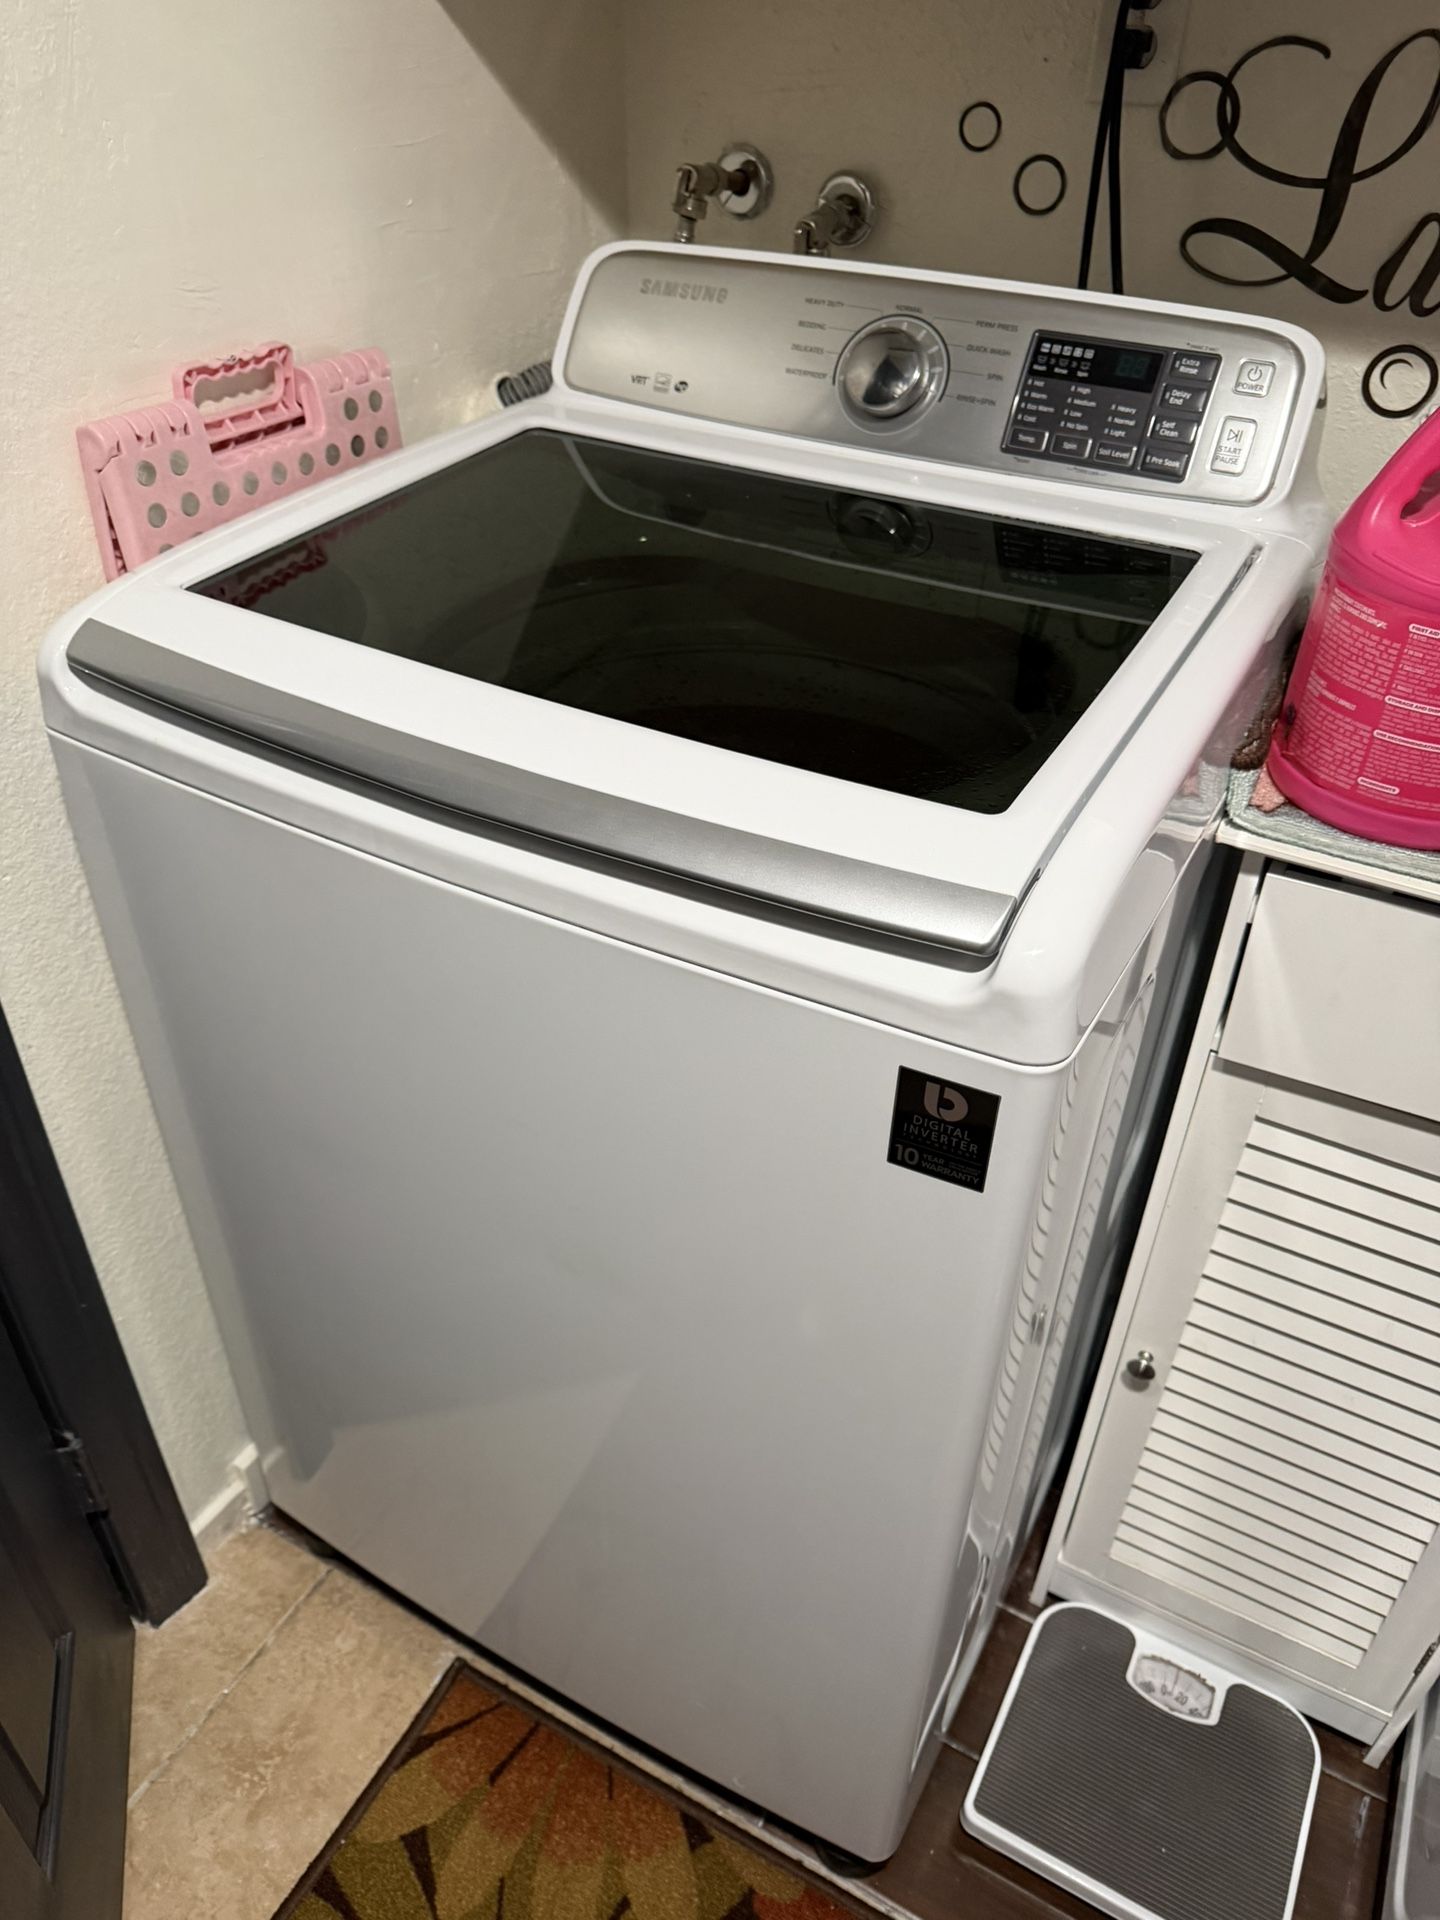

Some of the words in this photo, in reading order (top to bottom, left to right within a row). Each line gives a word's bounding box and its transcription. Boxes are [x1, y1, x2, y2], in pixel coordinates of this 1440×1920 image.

[640, 278, 729, 304] SAMSUNG
[805, 297, 826, 305] HEAVY
[975, 320, 996, 329] PERM
[997, 323, 1018, 332] PRESS
[966, 344, 988, 354] QUICK
[989, 347, 1011, 356] WASH
[1181, 358, 1200, 367] Extra
[1179, 366, 1198, 375] Rinse
[987, 373, 1003, 381] SPIN
[1033, 380, 1045, 388] Hot
[1238, 382, 1264, 393] POWER
[1076, 386, 1091, 395] High
[1171, 389, 1192, 400] Delay
[1073, 398, 1097, 407] Medium
[1168, 397, 1184, 406] End
[1069, 410, 1082, 418] Low
[1117, 405, 1137, 415] Heavy
[1113, 417, 1136, 427] Normal
[1162, 420, 1176, 430] Self
[1109, 428, 1126, 438] Light
[1159, 428, 1179, 438] Clean
[1063, 441, 1078, 450] Spin
[1217, 445, 1242, 455] START
[1099, 447, 1111, 457] Soil
[1111, 449, 1130, 459] Level
[1151, 456, 1163, 466] Pre
[1164, 458, 1181, 468] Soak
[1214, 456, 1240, 466] PAUSE
[1411, 625, 1429, 634] FIRST
[1428, 629, 1440, 638] AID
[913, 1113, 971, 1142] DIGITAL
[903, 1122, 979, 1155] INVERTER
[895, 1143, 920, 1166] 10
[922, 1153, 945, 1166] YEAR
[921, 1159, 980, 1185] WARRANTY
